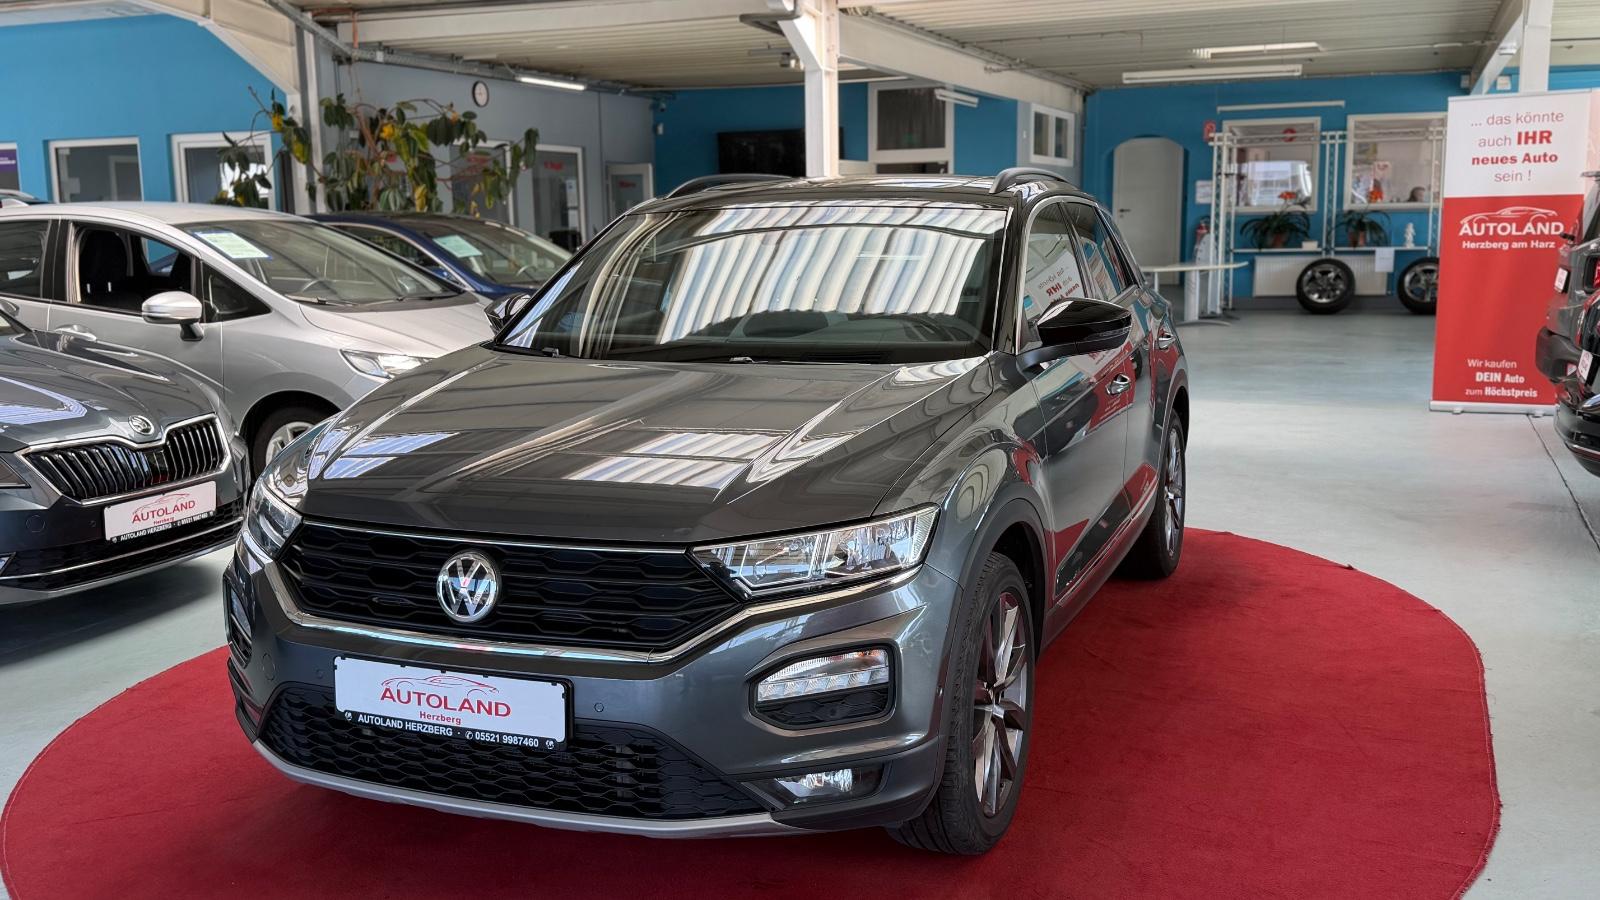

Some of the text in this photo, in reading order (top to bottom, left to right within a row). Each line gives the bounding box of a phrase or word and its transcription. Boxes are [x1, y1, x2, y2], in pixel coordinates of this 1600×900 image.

[1486, 114, 1512, 126] das
[1516, 111, 1565, 124] könnte
[1478, 130, 1553, 148] auch IHR
[1471, 152, 1559, 166] neues Auto
[1494, 171, 1523, 182] sein
[1458, 221, 1565, 236] AUTOLAND
[1462, 240, 1556, 250] Herzberg am Harz
[1467, 358, 1517, 369] Wir kaufen
[1475, 371, 1526, 384] DEIN Auto
[1465, 386, 1538, 398] zum Höchstpreis
[132, 500, 196, 523] AUTOLAND
[380, 687, 511, 717] AUTOLAND
[419, 710, 461, 726] Herzberg
[357, 714, 539, 748] AUTOLAND HERZBERG 05521 9987460
